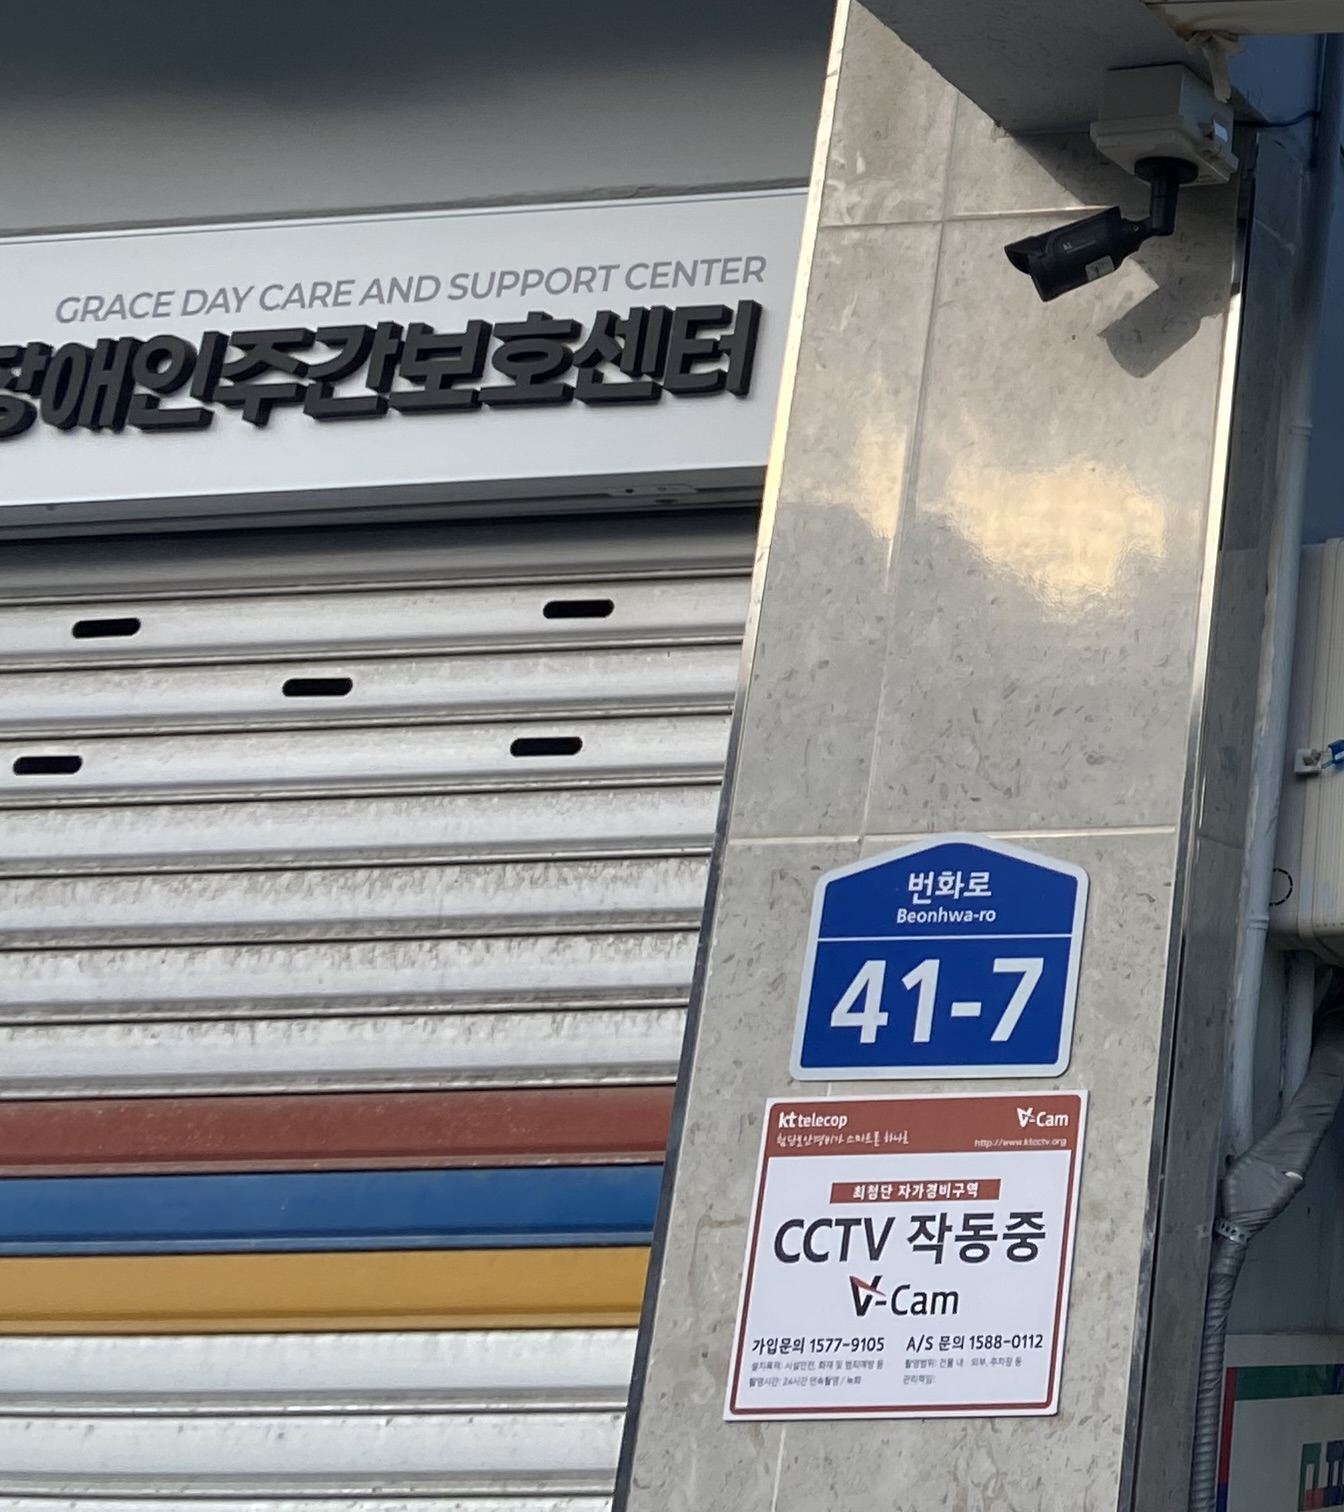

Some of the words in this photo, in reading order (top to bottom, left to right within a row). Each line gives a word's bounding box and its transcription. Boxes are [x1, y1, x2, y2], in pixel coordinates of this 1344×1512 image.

[55, 289, 174, 325] GRACE
[181, 286, 256, 316] DAY
[259, 279, 353, 313] CARE
[362, 274, 442, 307] AND
[448, 263, 621, 301] SUPPORT
[625, 254, 767, 291] CENTER
[908, 870, 993, 904] 번화로
[896, 907, 997, 924] Beonhwa-ro
[830, 957, 1045, 1044] 41-7
[1016, 1107, 1069, 1128] V-Cam
[852, 1183, 893, 1201] 최첨단
[773, 1216, 897, 1265] CCTV
[906, 1211, 1047, 1265] 작동중
[850, 1275, 960, 1318] V-Cam
[752, 1337, 805, 1356] 가입문의
[809, 1337, 885, 1353] 1577-9105
[906, 1336, 934, 1353] A/S
[938, 1335, 966, 1352] 문의
[969, 1334, 1044, 1350] 1588-0112
